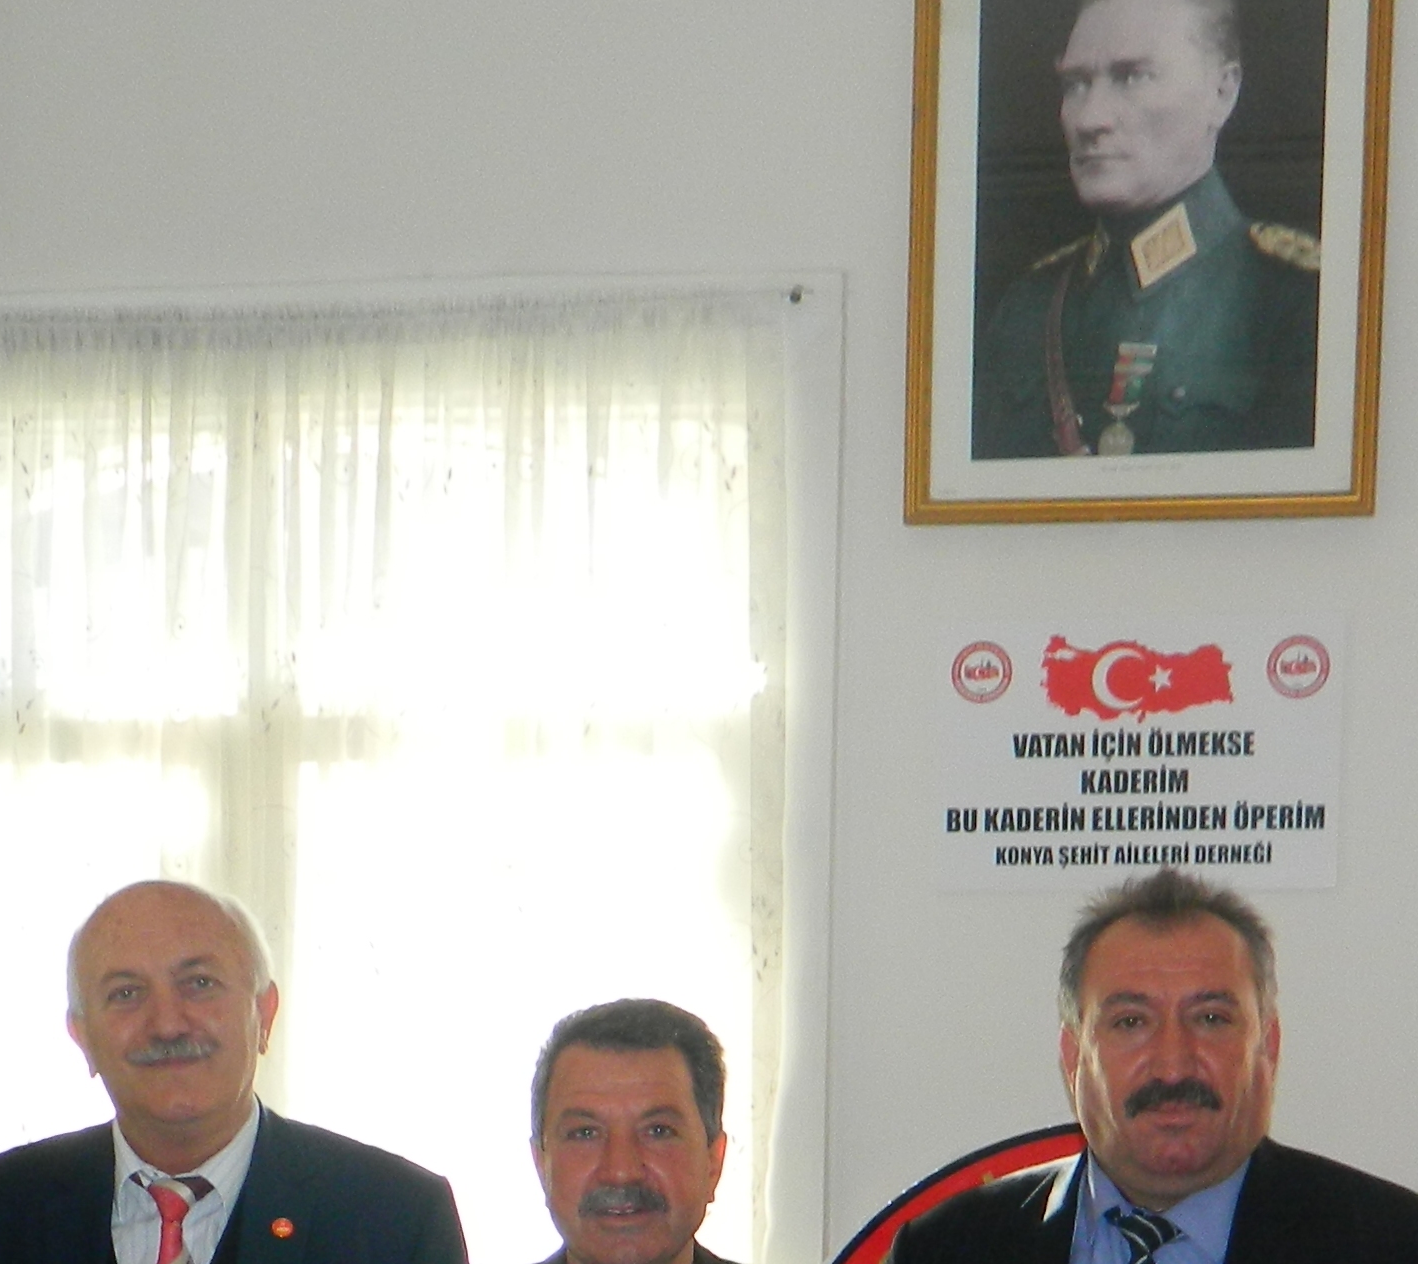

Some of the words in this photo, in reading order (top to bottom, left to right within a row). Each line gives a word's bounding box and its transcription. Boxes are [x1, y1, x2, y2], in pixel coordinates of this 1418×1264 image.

[1013, 733, 1085, 758] VATAN
[1092, 728, 1141, 762] İÇİN
[1148, 729, 1255, 757] ÖLMEKSE
[1081, 767, 1189, 795] KADERİM
[946, 808, 978, 833] BU
[984, 802, 1085, 832] KADERİN
[1092, 801, 1227, 831] ELLERİNDEN
[1233, 800, 1326, 831] ÖPERİM
[996, 846, 1054, 866] KONYA
[1058, 843, 1110, 870] ŞEHİT
[1114, 842, 1190, 866] AİLELERİ
[1194, 841, 1272, 865] DERNEĞİ
